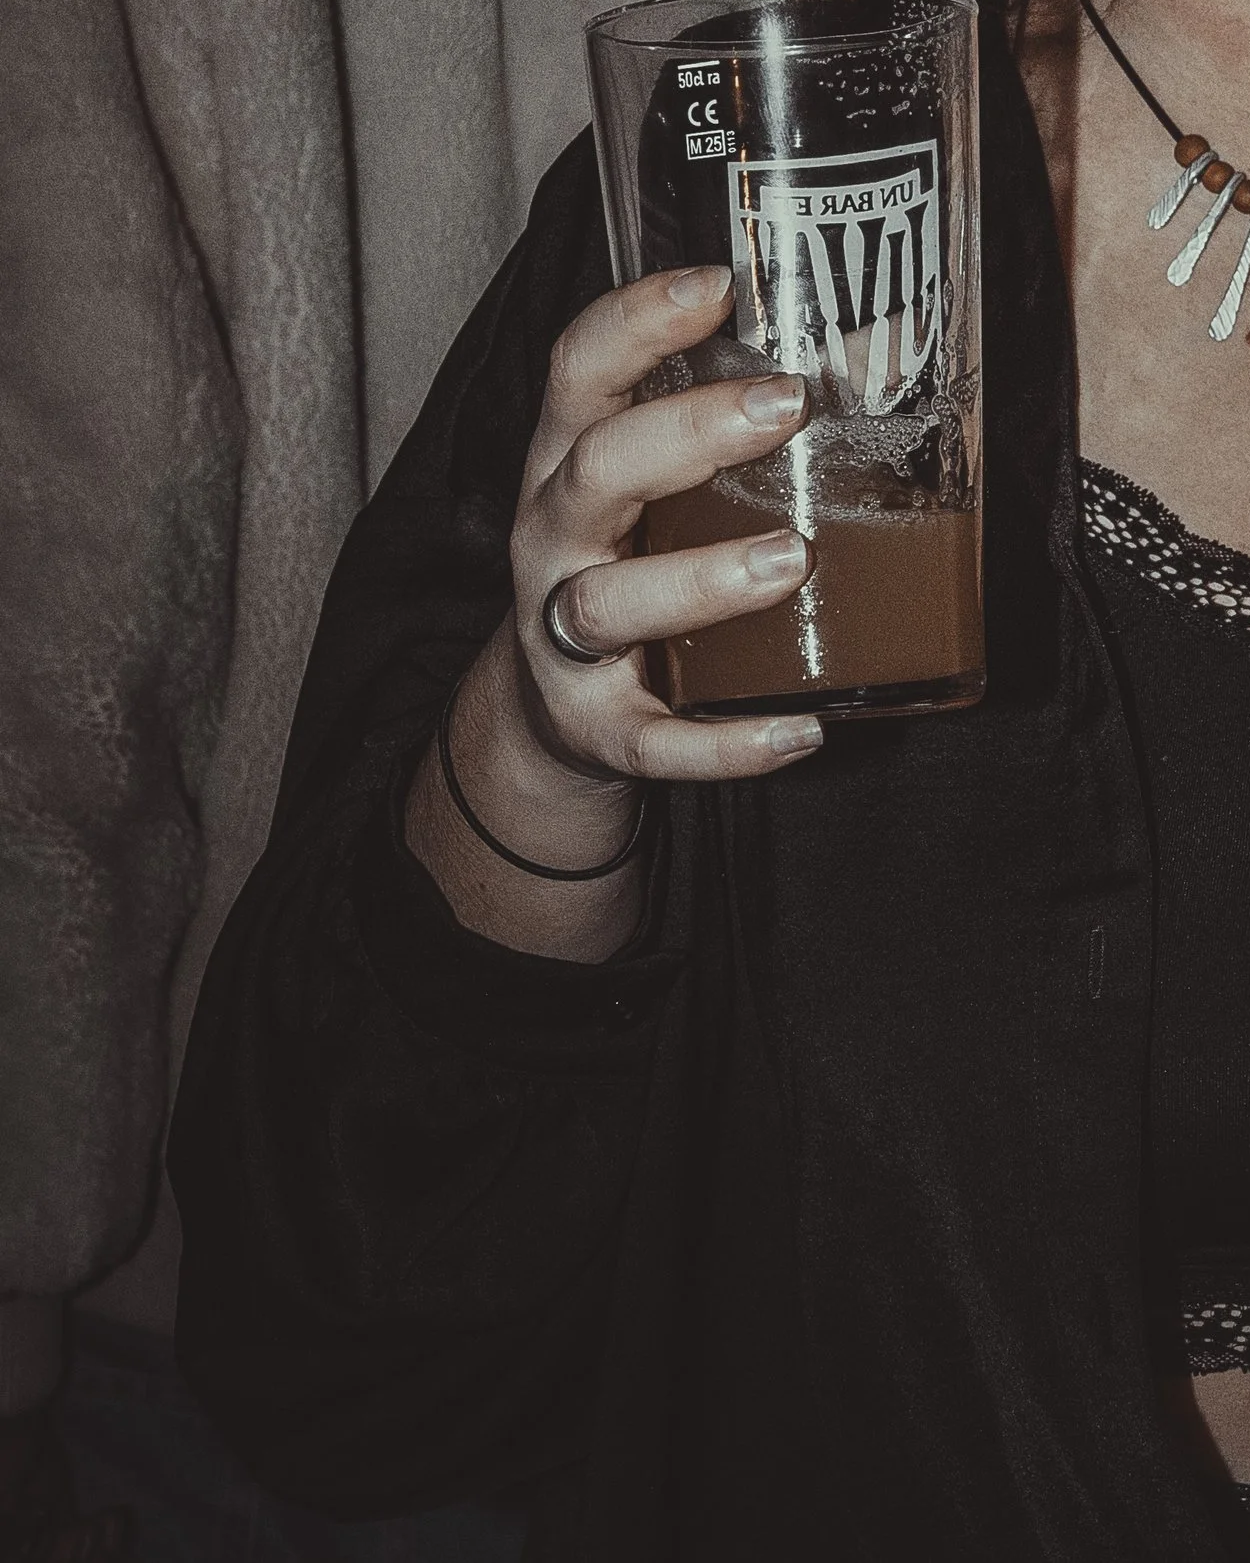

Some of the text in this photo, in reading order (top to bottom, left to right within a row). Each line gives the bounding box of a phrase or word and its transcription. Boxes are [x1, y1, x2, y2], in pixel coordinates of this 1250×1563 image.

[687, 98, 719, 127] CE
[690, 135, 722, 155] M 25
[726, 130, 736, 153] 0113
